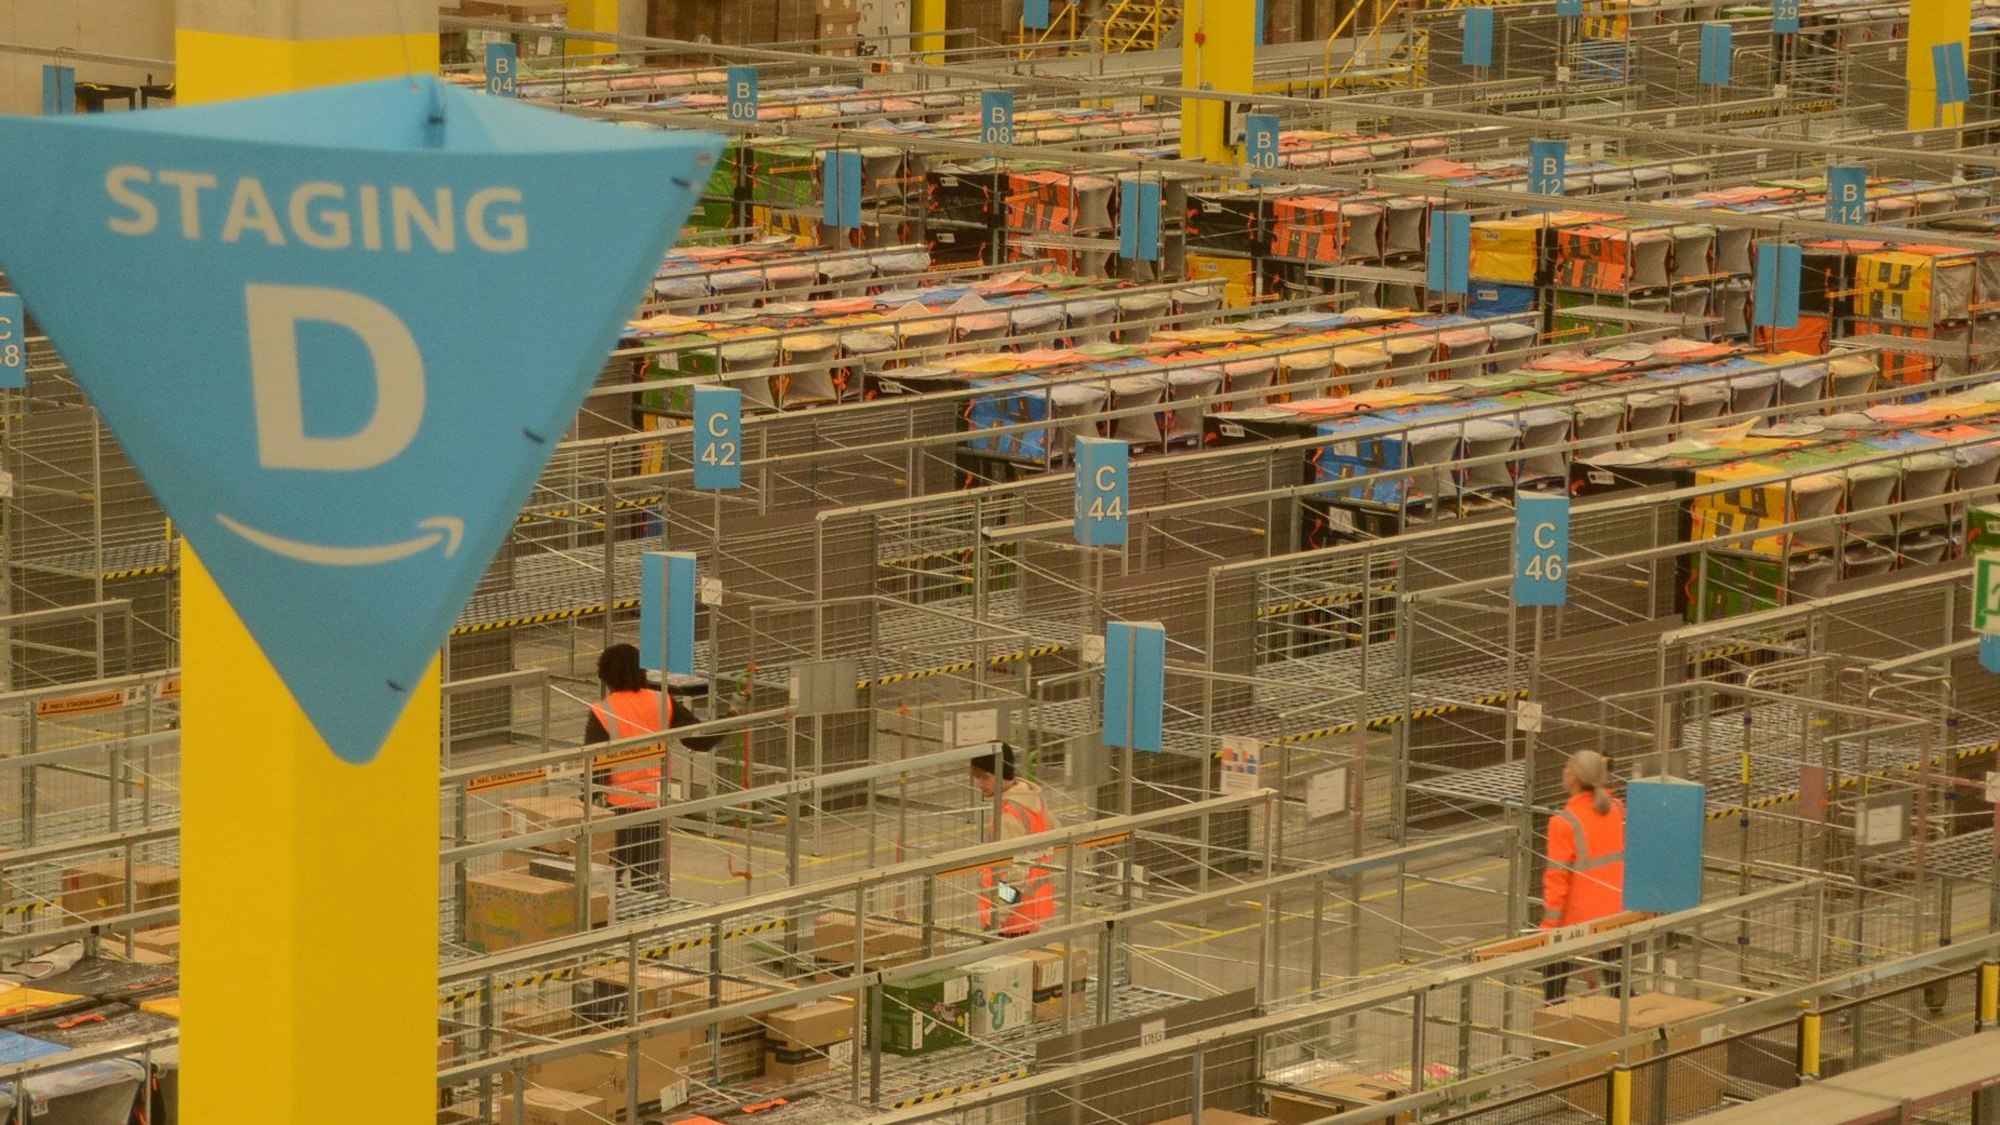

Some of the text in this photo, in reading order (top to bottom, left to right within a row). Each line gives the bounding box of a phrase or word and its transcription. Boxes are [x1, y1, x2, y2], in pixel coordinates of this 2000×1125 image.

[1778, 6, 1797, 20] 29
[496, 58, 509, 75] B
[491, 77, 514, 94] 04
[737, 82, 750, 98] B
[732, 103, 755, 118] 06
[992, 107, 1005, 123] B
[987, 127, 1010, 144] 08
[1257, 132, 1271, 148] B
[1253, 152, 1275, 168] 10
[1543, 157, 1557, 175] B
[1538, 178, 1561, 196] 12
[1843, 183, 1857, 202] B
[105, 163, 529, 253] STAGING
[1838, 205, 1862, 224] 14
[0, 344, 20, 368] 8
[244, 281, 426, 472] D
[708, 412, 729, 438] C
[701, 442, 736, 467] 42
[1095, 465, 1116, 491] C
[1088, 496, 1123, 522] 44
[1533, 522, 1556, 549] C
[1525, 554, 1562, 581] 46
